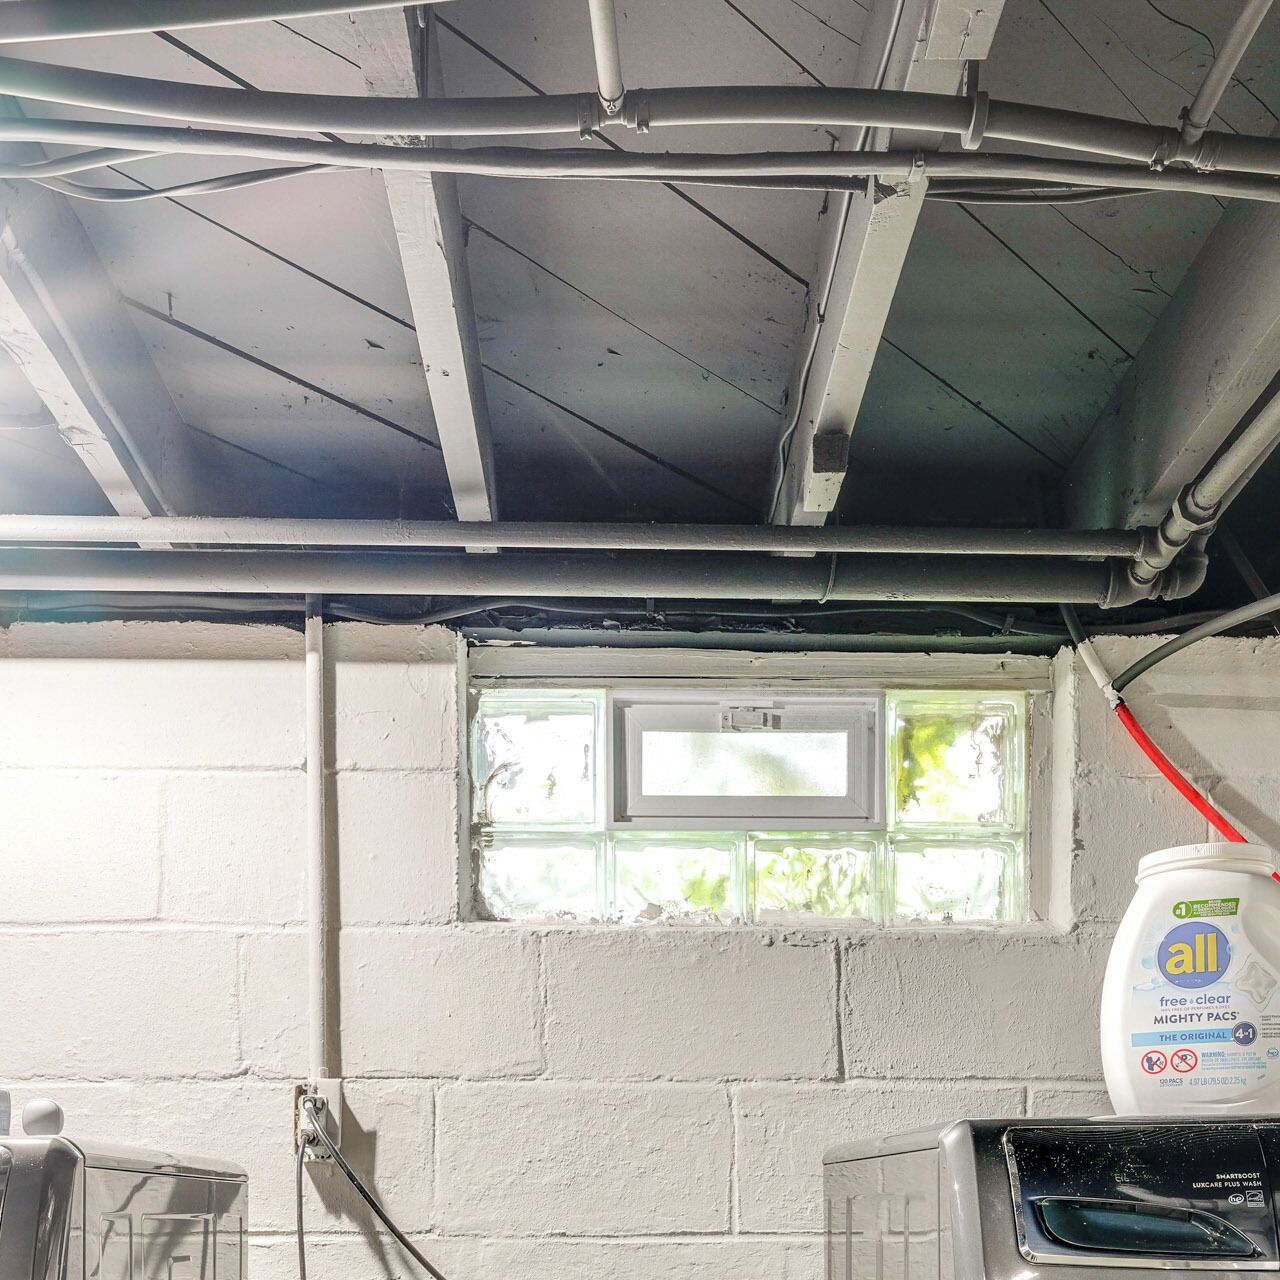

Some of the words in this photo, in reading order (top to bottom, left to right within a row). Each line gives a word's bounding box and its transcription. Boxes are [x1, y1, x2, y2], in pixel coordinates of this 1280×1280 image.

[1165, 932, 1218, 975] all
[1160, 996, 1187, 1007] free
[1195, 994, 1231, 1005] clear
[1153, 1013, 1203, 1025] MIGHTY
[1207, 1012, 1237, 1022] PACS
[1160, 1034, 1177, 1042] THE
[1183, 1031, 1227, 1041] ORIGINAL
[1192, 1181, 1223, 1189] LUXCARE
[1242, 1180, 1262, 1188] WASH
[1229, 1195, 1243, 1204] he
